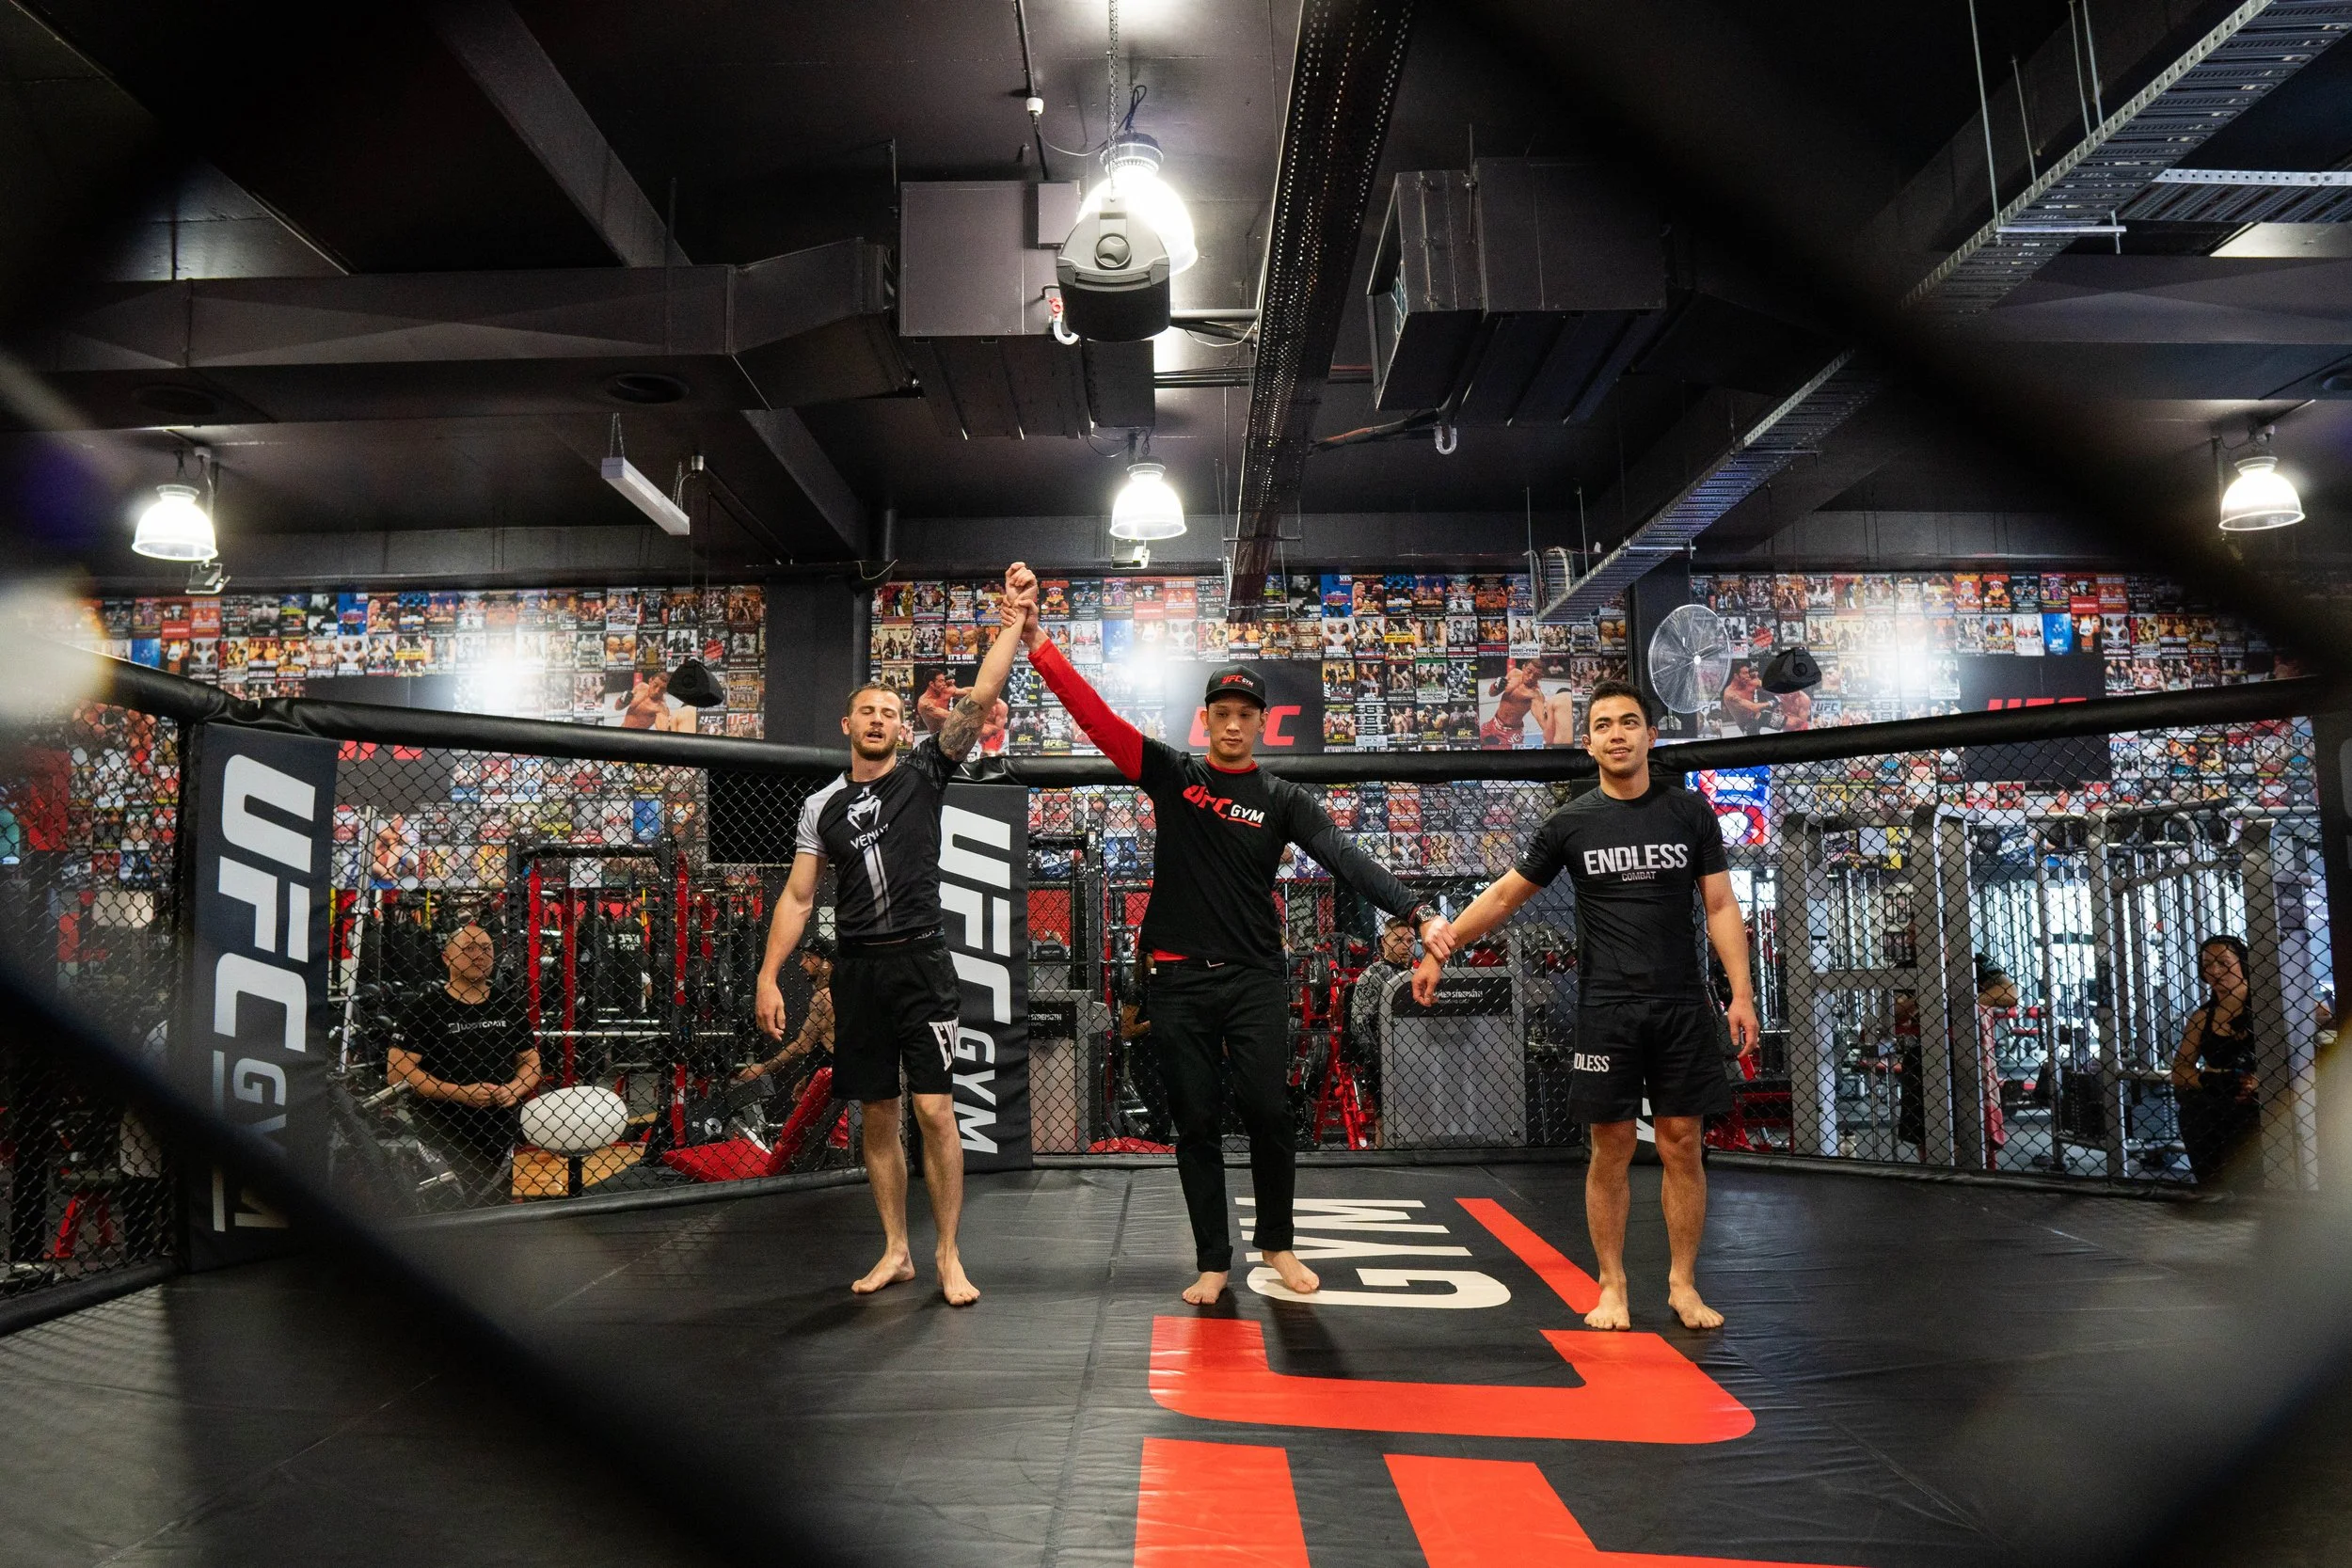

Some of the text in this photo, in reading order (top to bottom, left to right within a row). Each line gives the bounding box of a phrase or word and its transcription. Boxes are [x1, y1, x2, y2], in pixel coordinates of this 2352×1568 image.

[1221, 674, 1254, 687] UFC GYM
[1183, 784, 1264, 823] UFC GYM
[1583, 843, 1689, 875] ENDLESS
[1621, 871, 1657, 881] COMBAT
[215, 754, 316, 1053] UFC
[938, 805, 1010, 1154] UFC GYM
[1234, 1197, 1511, 1308] GYM
